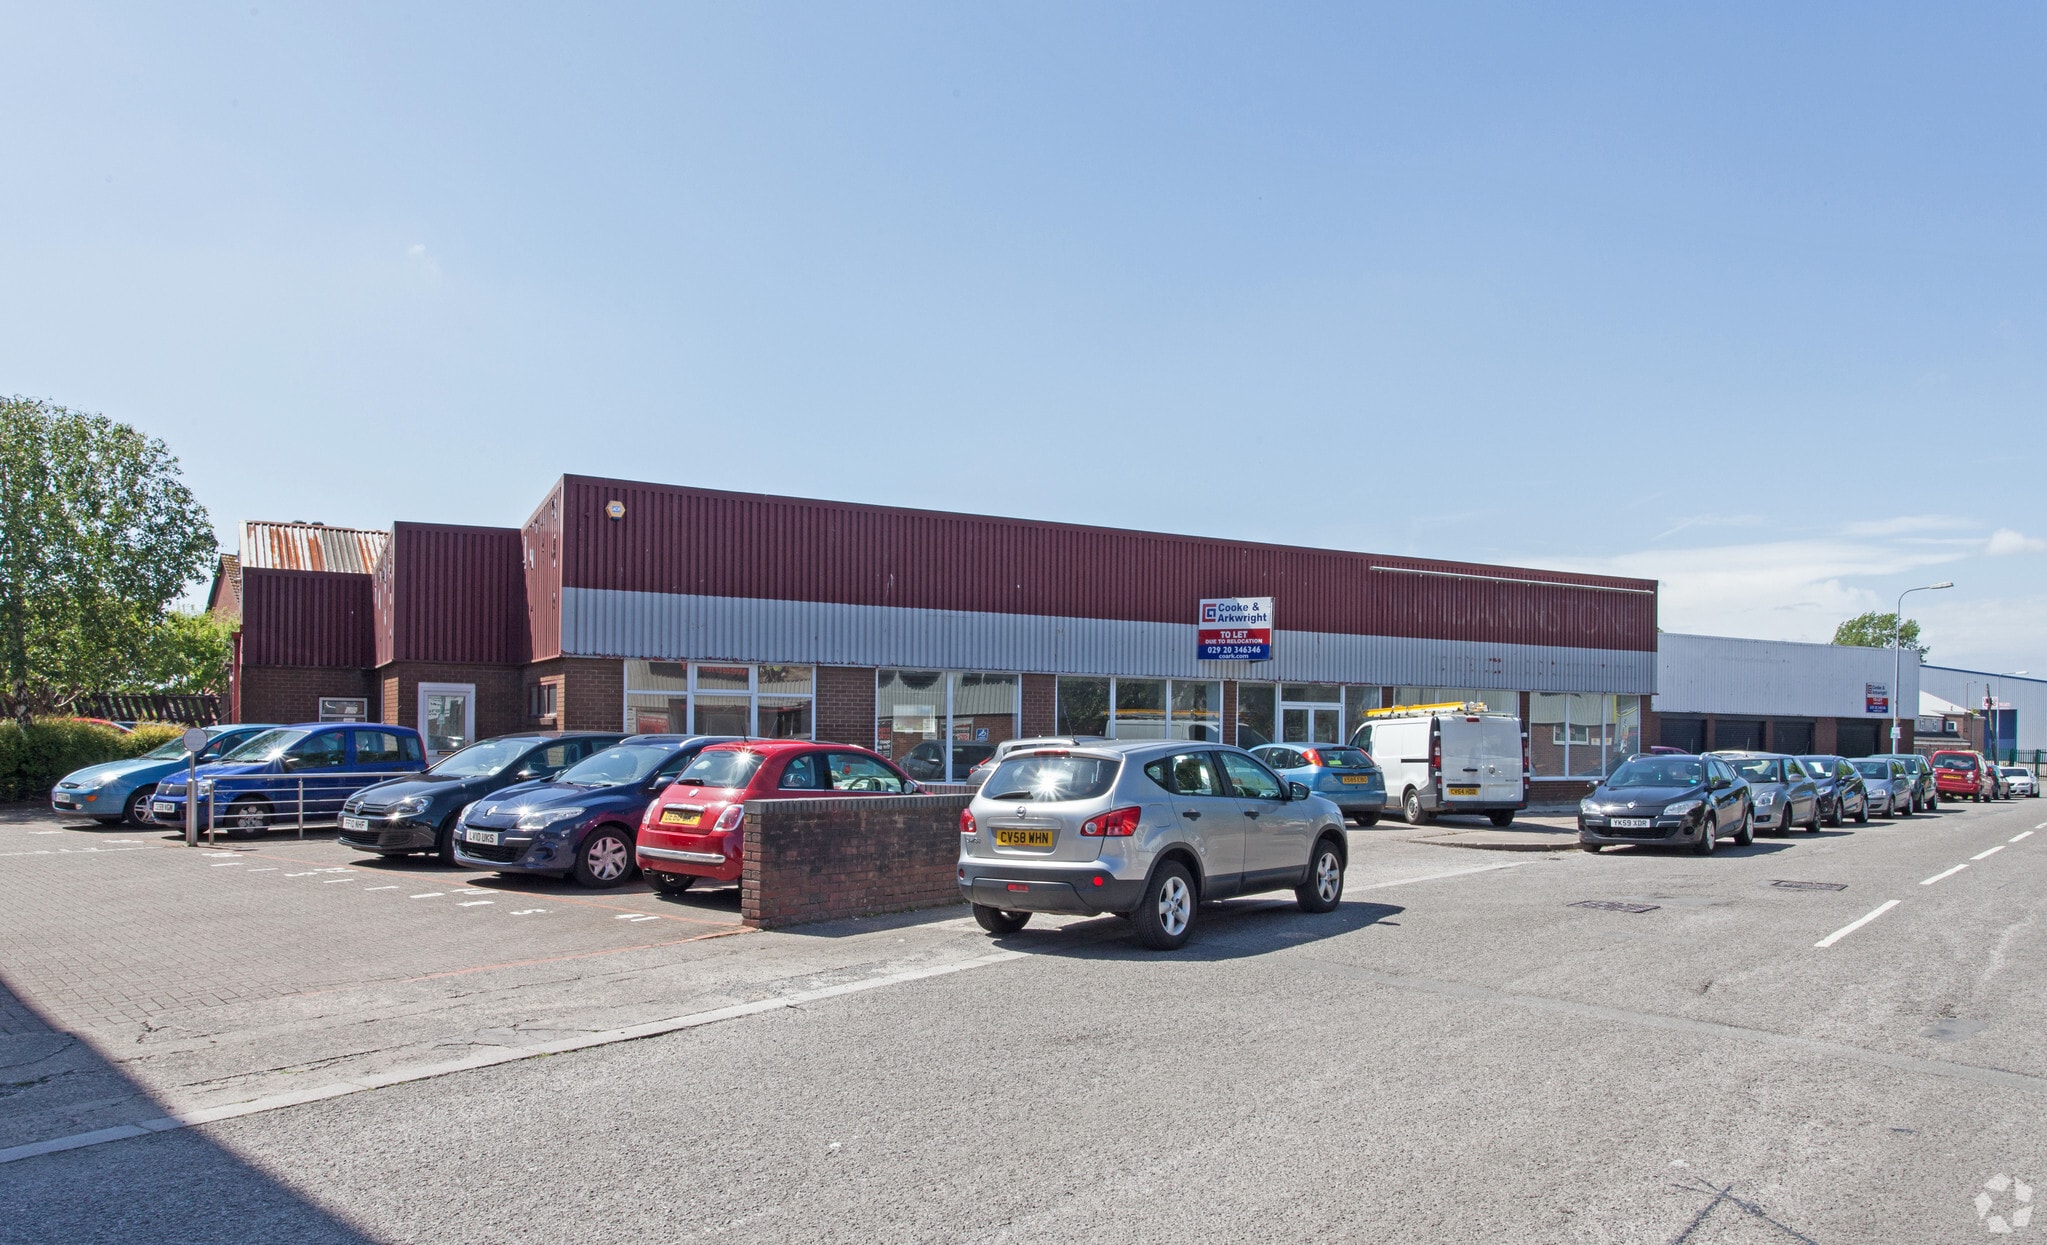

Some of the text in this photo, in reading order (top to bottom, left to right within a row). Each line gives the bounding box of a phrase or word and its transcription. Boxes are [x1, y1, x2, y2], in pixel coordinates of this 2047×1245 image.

[1218, 602, 1260, 612] Cooke &
[1217, 613, 1267, 624] Arkwright
[1220, 631, 1248, 639] TO LET
[1207, 646, 1261, 654] 029 20 346346
[1613, 819, 1631, 827] YK59
[468, 831, 495, 843] LV10 UKS
[1000, 831, 1049, 844] CV58 WHN
